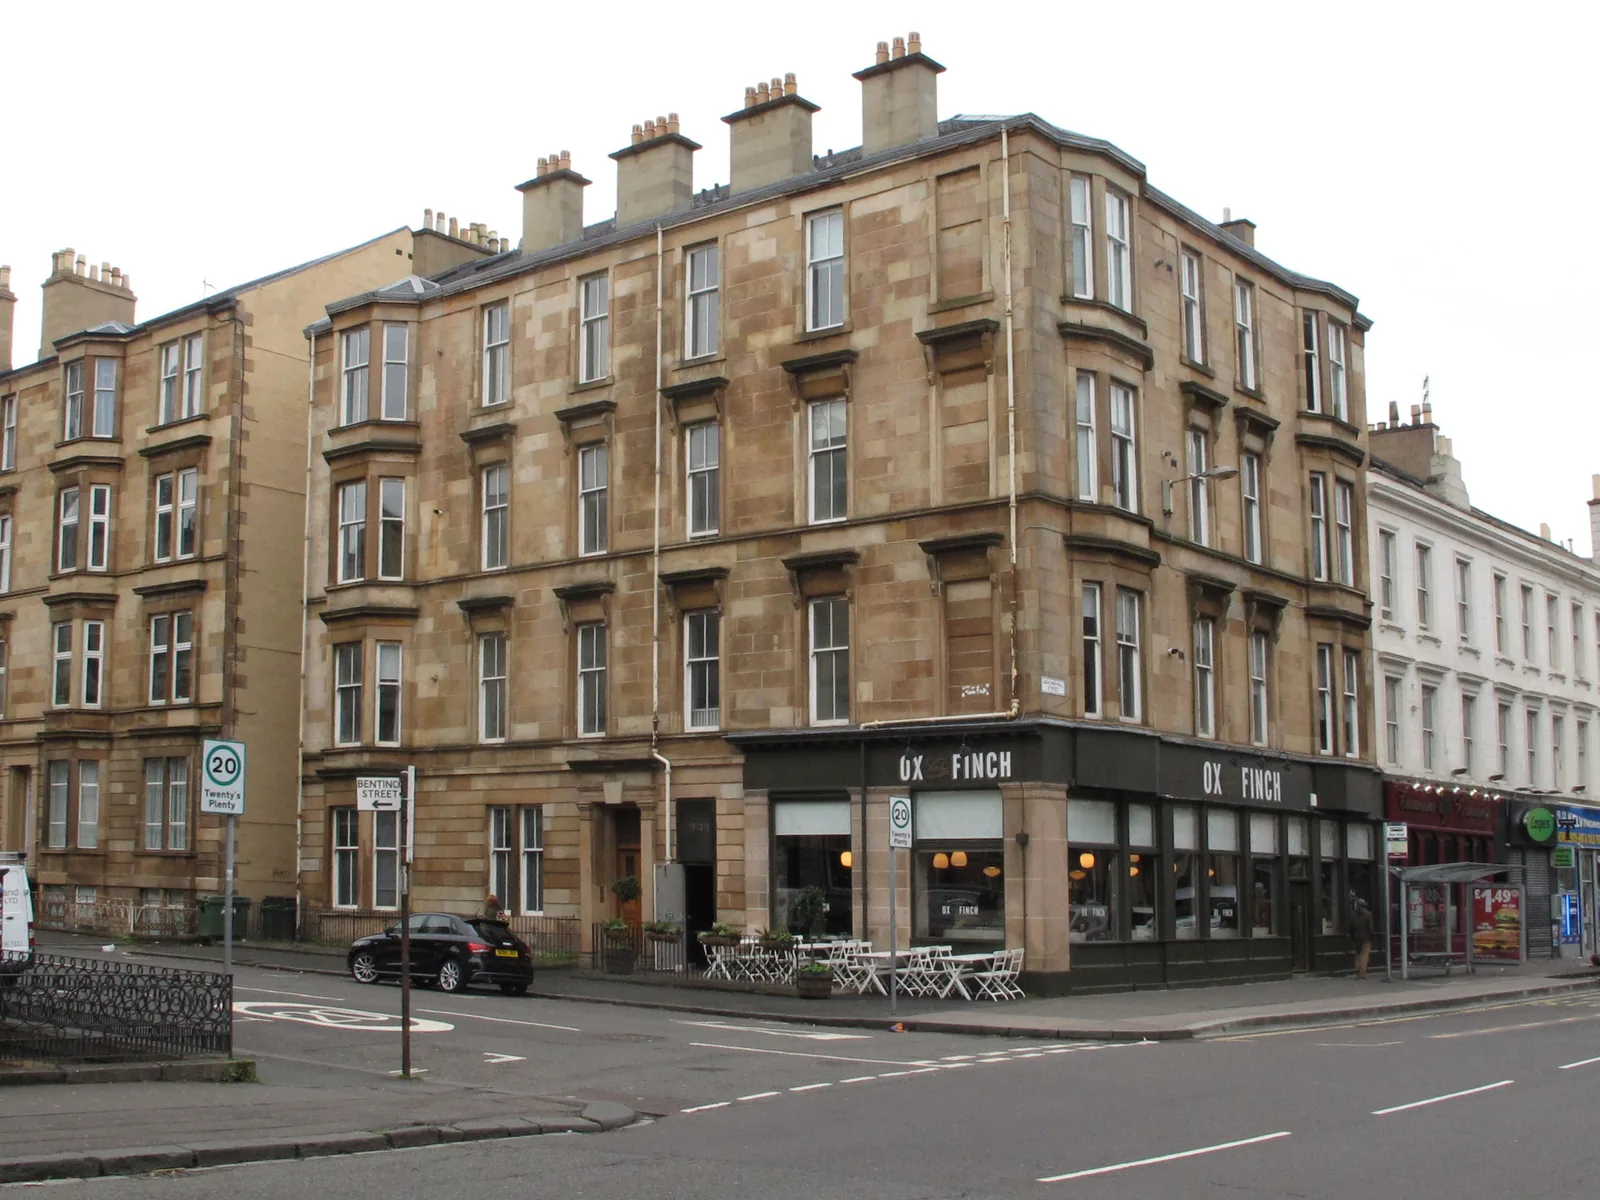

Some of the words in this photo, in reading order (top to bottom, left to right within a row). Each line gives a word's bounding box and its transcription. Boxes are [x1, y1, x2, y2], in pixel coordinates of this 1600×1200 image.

[212, 756, 236, 774] 20
[900, 754, 924, 781] OX
[952, 751, 1011, 780] FINCH
[1203, 761, 1222, 795] OX
[1242, 767, 1281, 802] FINCH
[205, 789, 241, 800] Twenty's
[362, 790, 398, 798] STREET
[209, 799, 236, 810] Plenty
[894, 808, 907, 820] 20
[892, 831, 910, 839] Twenty's
[894, 837, 907, 845] Plenty
[1474, 888, 1511, 913] £1.49
[941, 905, 951, 915] OX
[959, 905, 979, 915] FINCH
